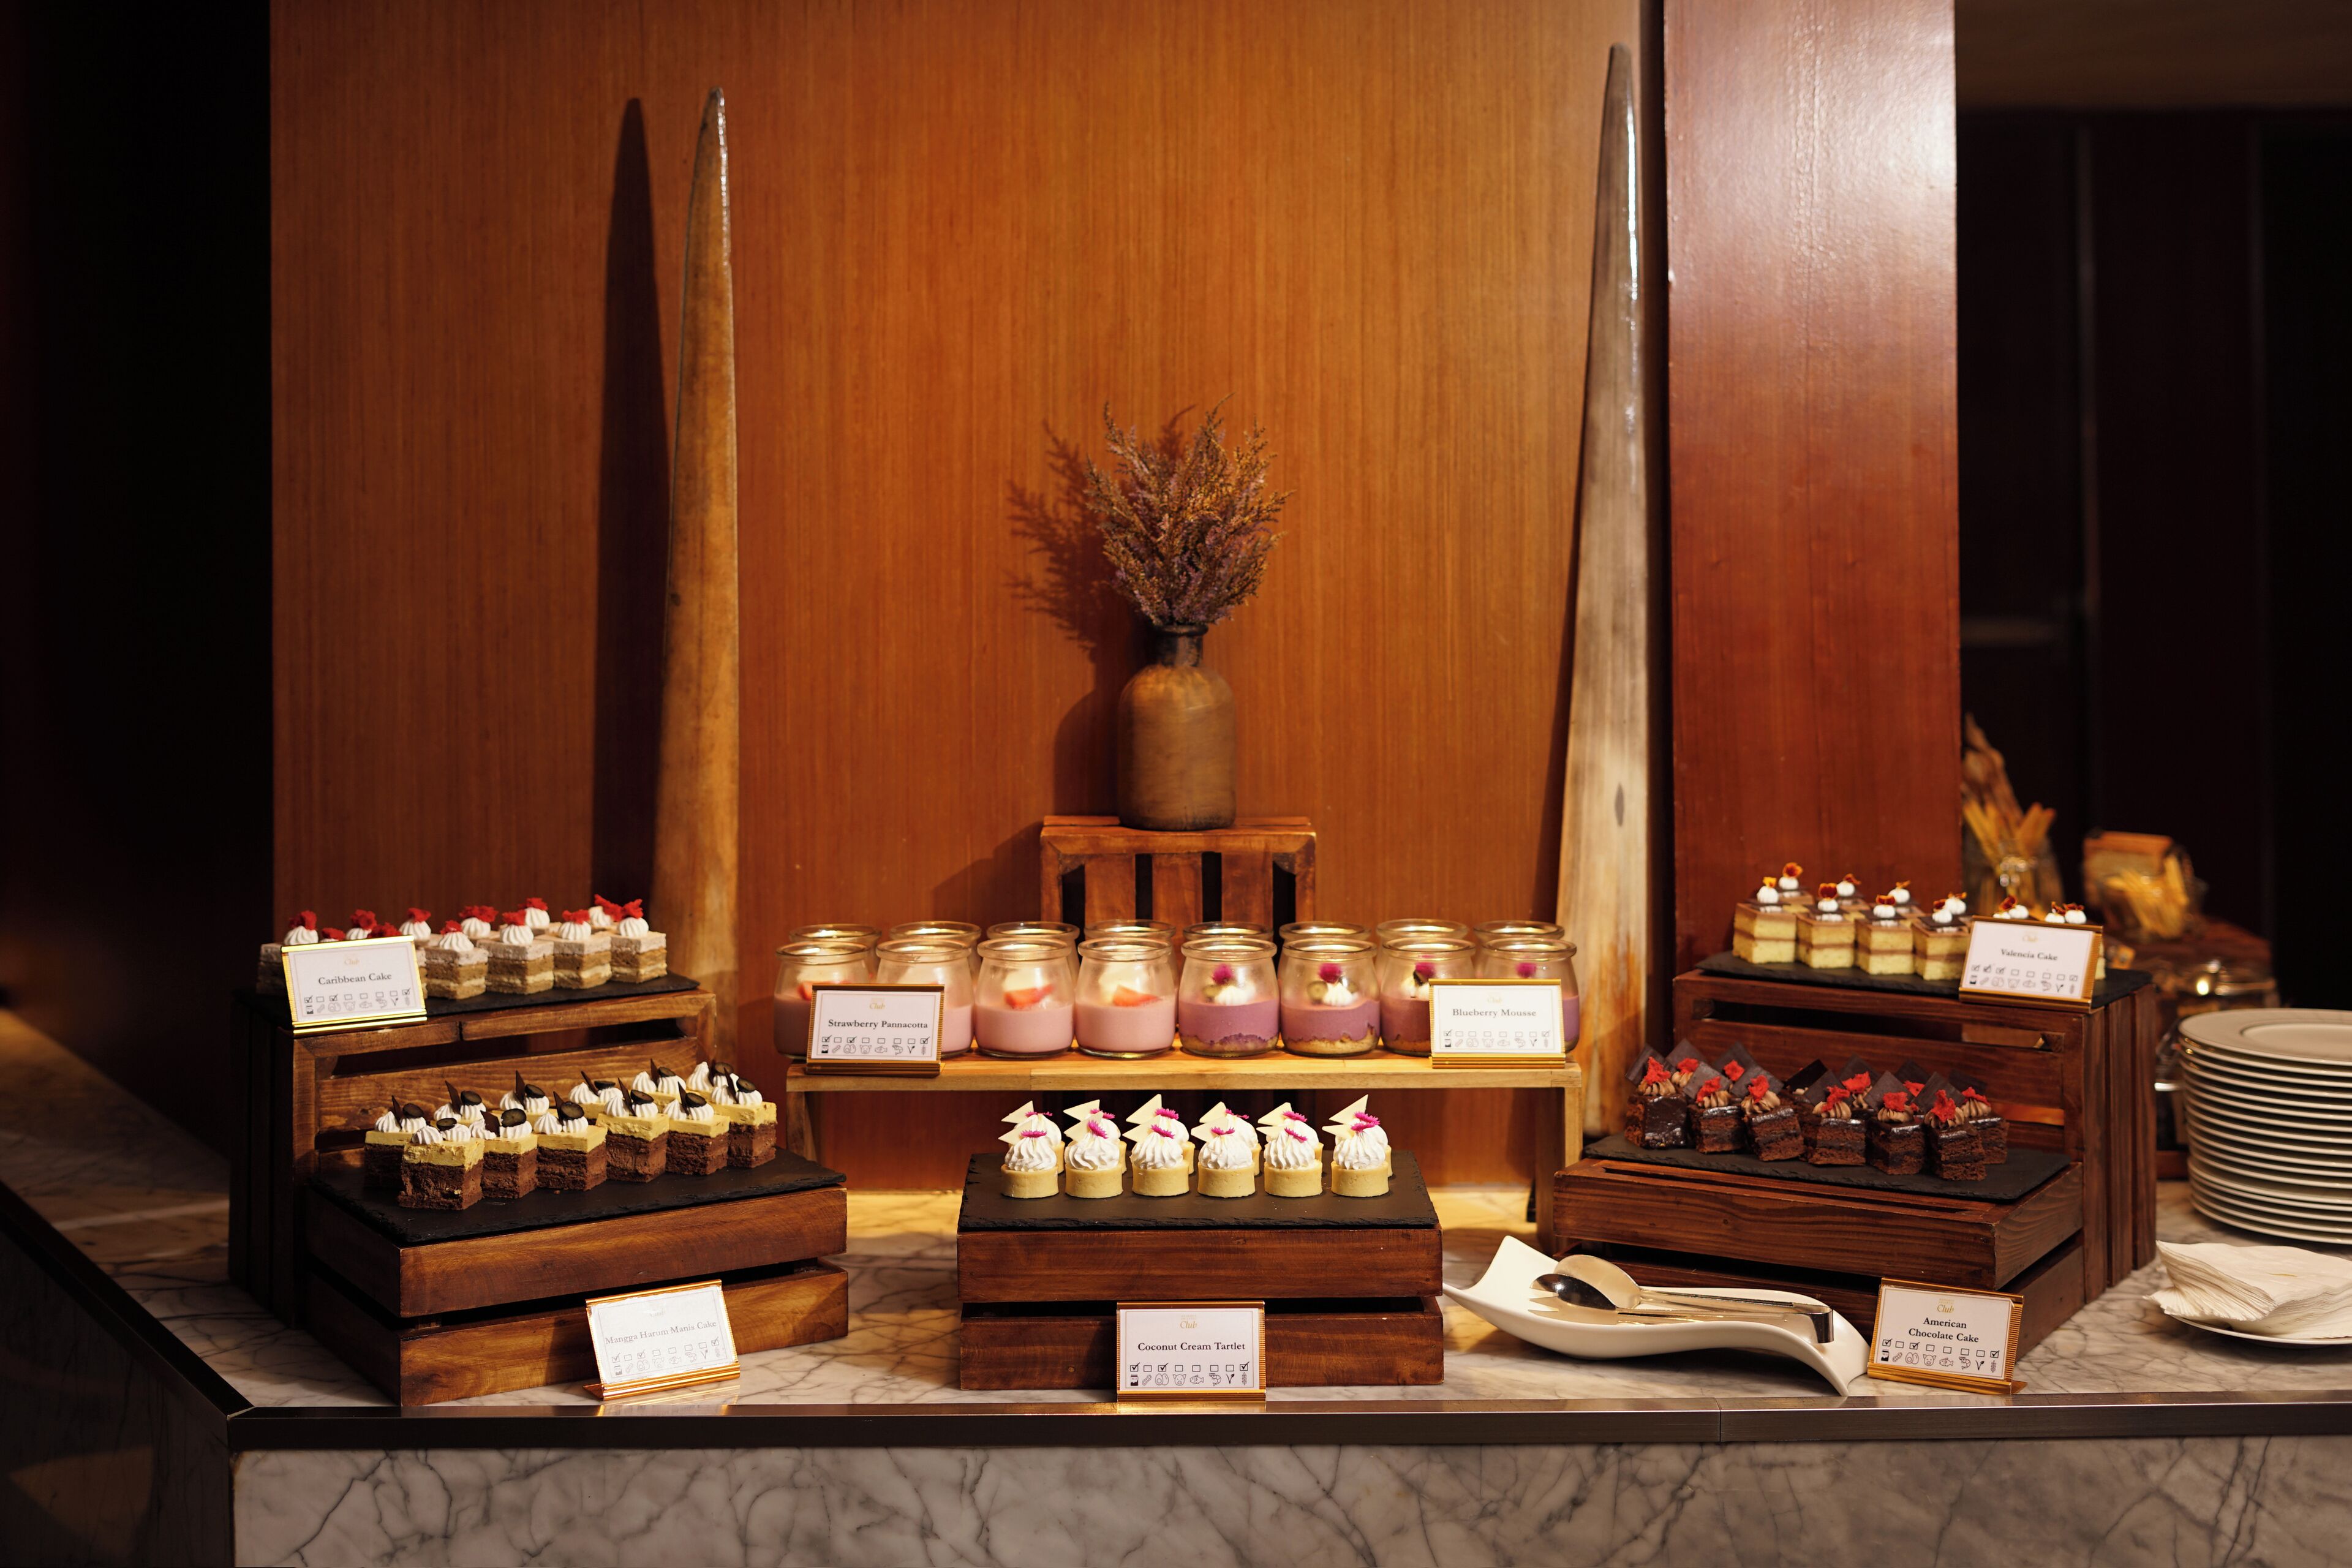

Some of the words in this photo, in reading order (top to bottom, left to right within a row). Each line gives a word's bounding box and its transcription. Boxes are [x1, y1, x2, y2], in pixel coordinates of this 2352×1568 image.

[2001, 949, 2034, 959] Valencia
[318, 974, 366, 985] Caribbean
[1452, 1009, 1498, 1017] Blueberry
[828, 1019, 878, 1029] Strawberry
[1937, 1304, 1954, 1313] Club
[1923, 1317, 1967, 1329] American
[605, 1334, 638, 1344] Mangga
[639, 1329, 669, 1338] Harum
[671, 1325, 695, 1334] Manis
[697, 1321, 717, 1329] Cake
[1909, 1328, 1953, 1340] Chocolate
[1956, 1333, 1979, 1343] Cake
[1138, 1342, 1177, 1351] Coconut
[1180, 1342, 1211, 1351] Cream
